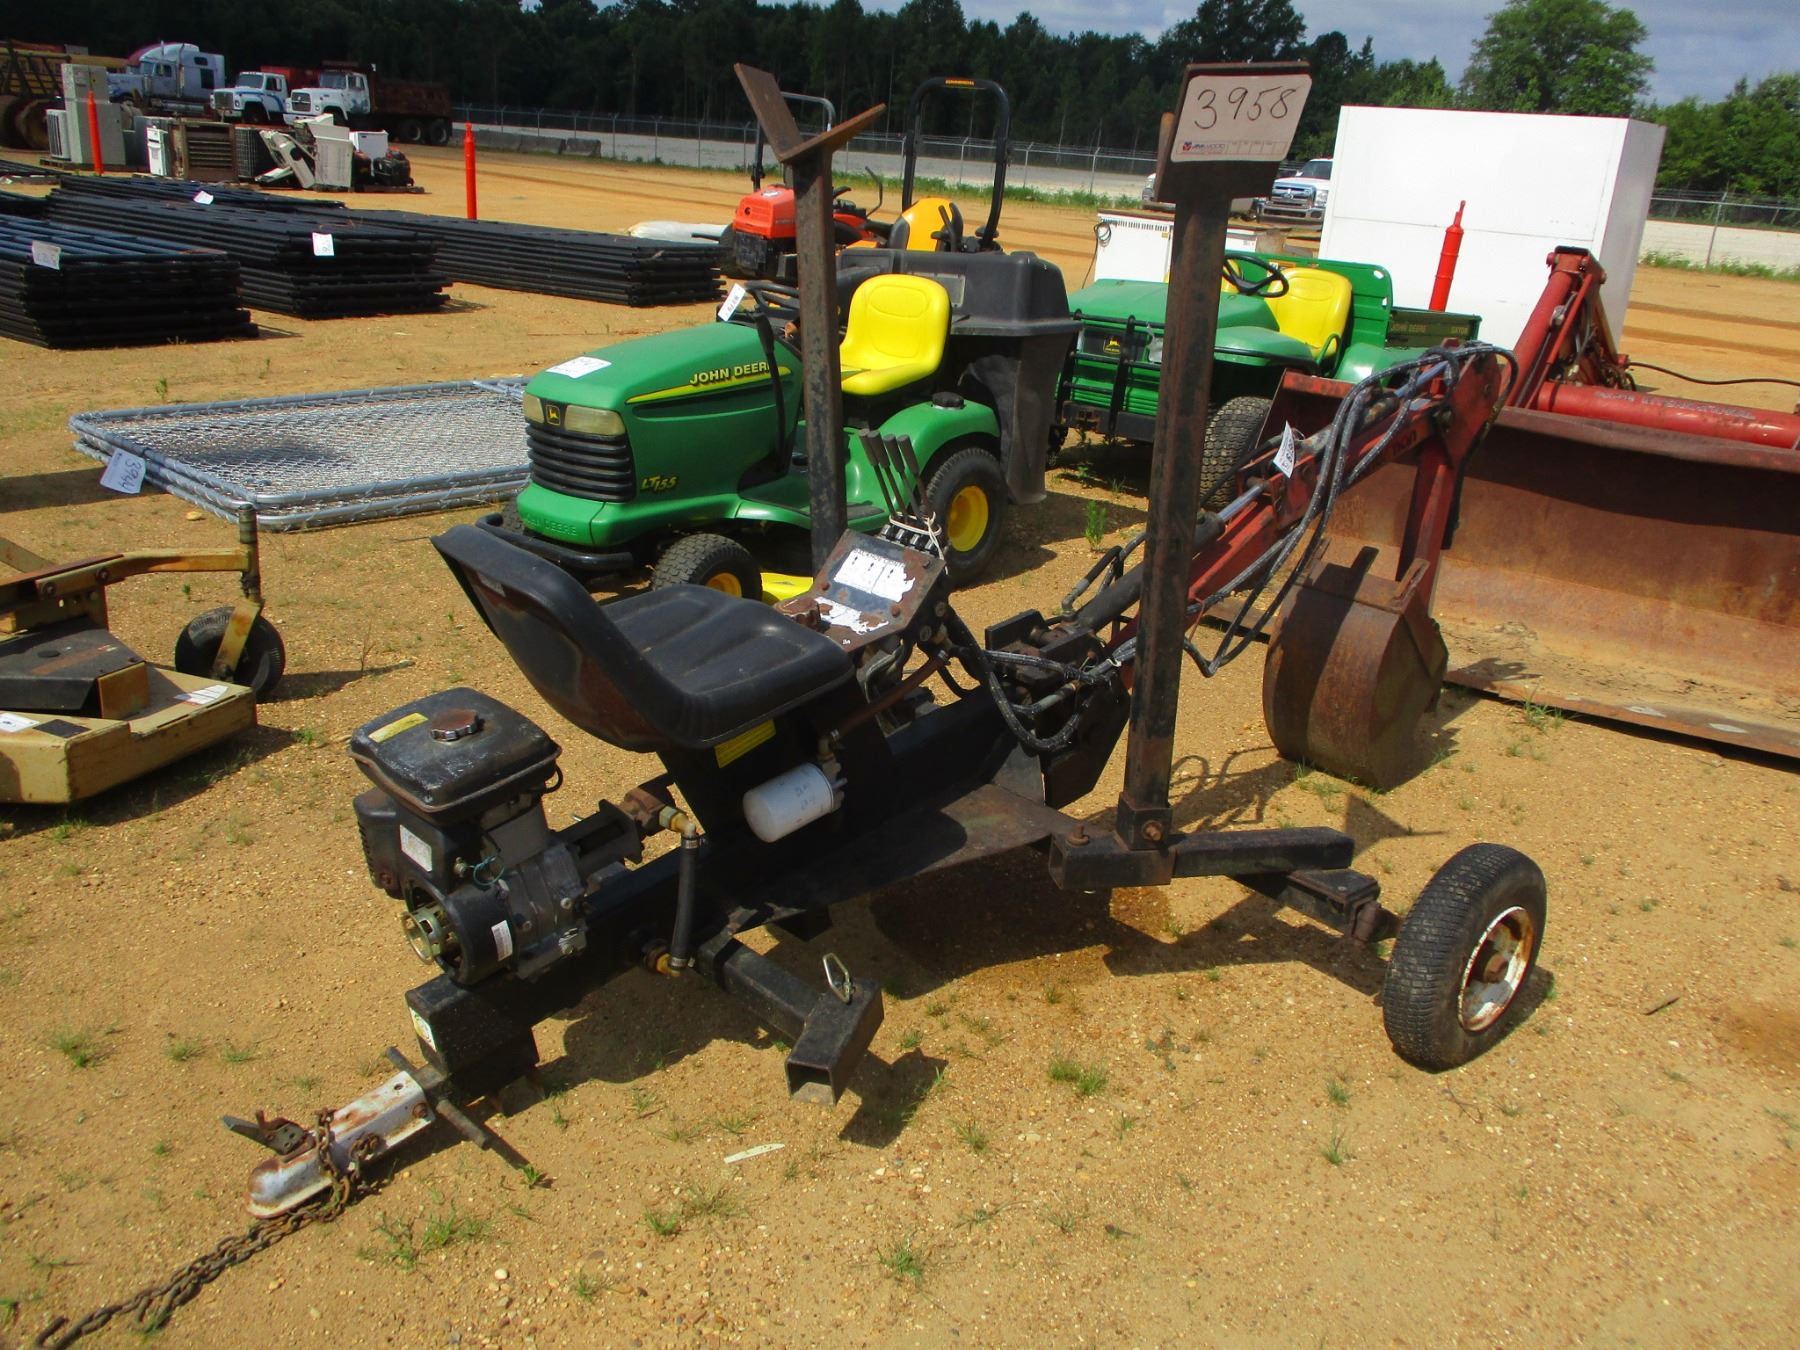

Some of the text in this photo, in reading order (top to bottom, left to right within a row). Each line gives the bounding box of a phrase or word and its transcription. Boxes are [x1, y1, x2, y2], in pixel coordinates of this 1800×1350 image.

[1194, 86, 1298, 129] 3958
[689, 361, 771, 385] JOHN DEER
[640, 475, 678, 491] LT155
